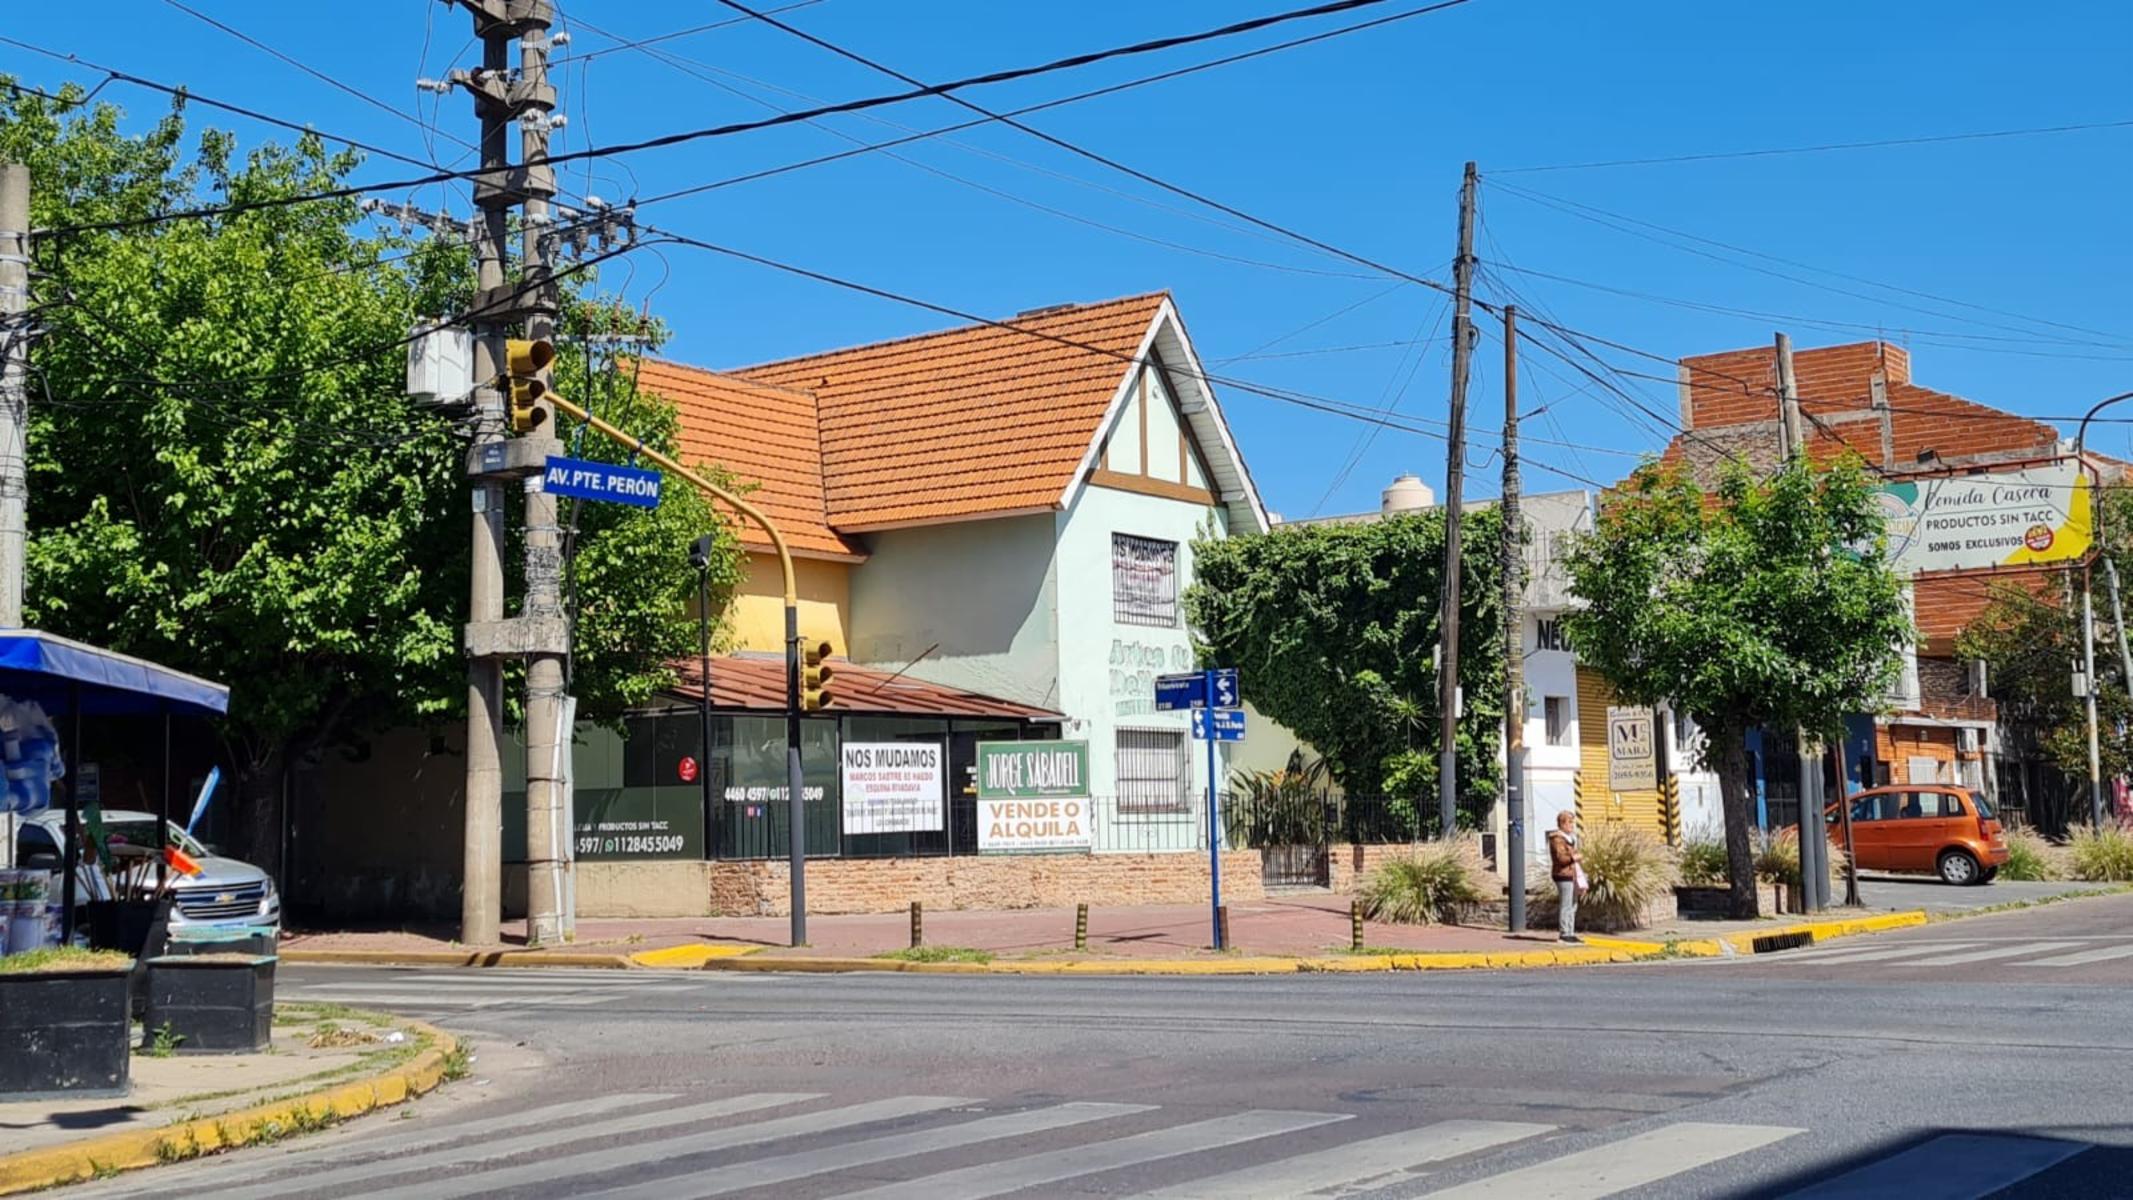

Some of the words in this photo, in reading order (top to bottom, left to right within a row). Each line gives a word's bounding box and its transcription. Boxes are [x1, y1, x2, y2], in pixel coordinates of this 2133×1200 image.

[547, 467, 570, 486] AV.
[572, 470, 604, 491] PTE.
[607, 475, 659, 498] PERÓN
[1992, 485, 2053, 506] Casera
[1926, 512, 1997, 531] PRODUCTOS
[2000, 511, 2020, 526] SIN
[2023, 510, 2054, 524] TACC
[1928, 540, 1961, 552] SOMOS
[1966, 536, 2023, 551] EXCLUSIVOS
[846, 749, 872, 769] NOS
[875, 749, 937, 769] MUDAMOS
[986, 753, 1023, 795] JORGE
[1026, 747, 1080, 787] SABADELL
[989, 802, 1060, 819] VENDE
[1064, 802, 1079, 817] O
[598, 821, 637, 831] PRODUCTOS
[638, 821, 650, 830] SIN
[989, 821, 1080, 839] ALQUILA
